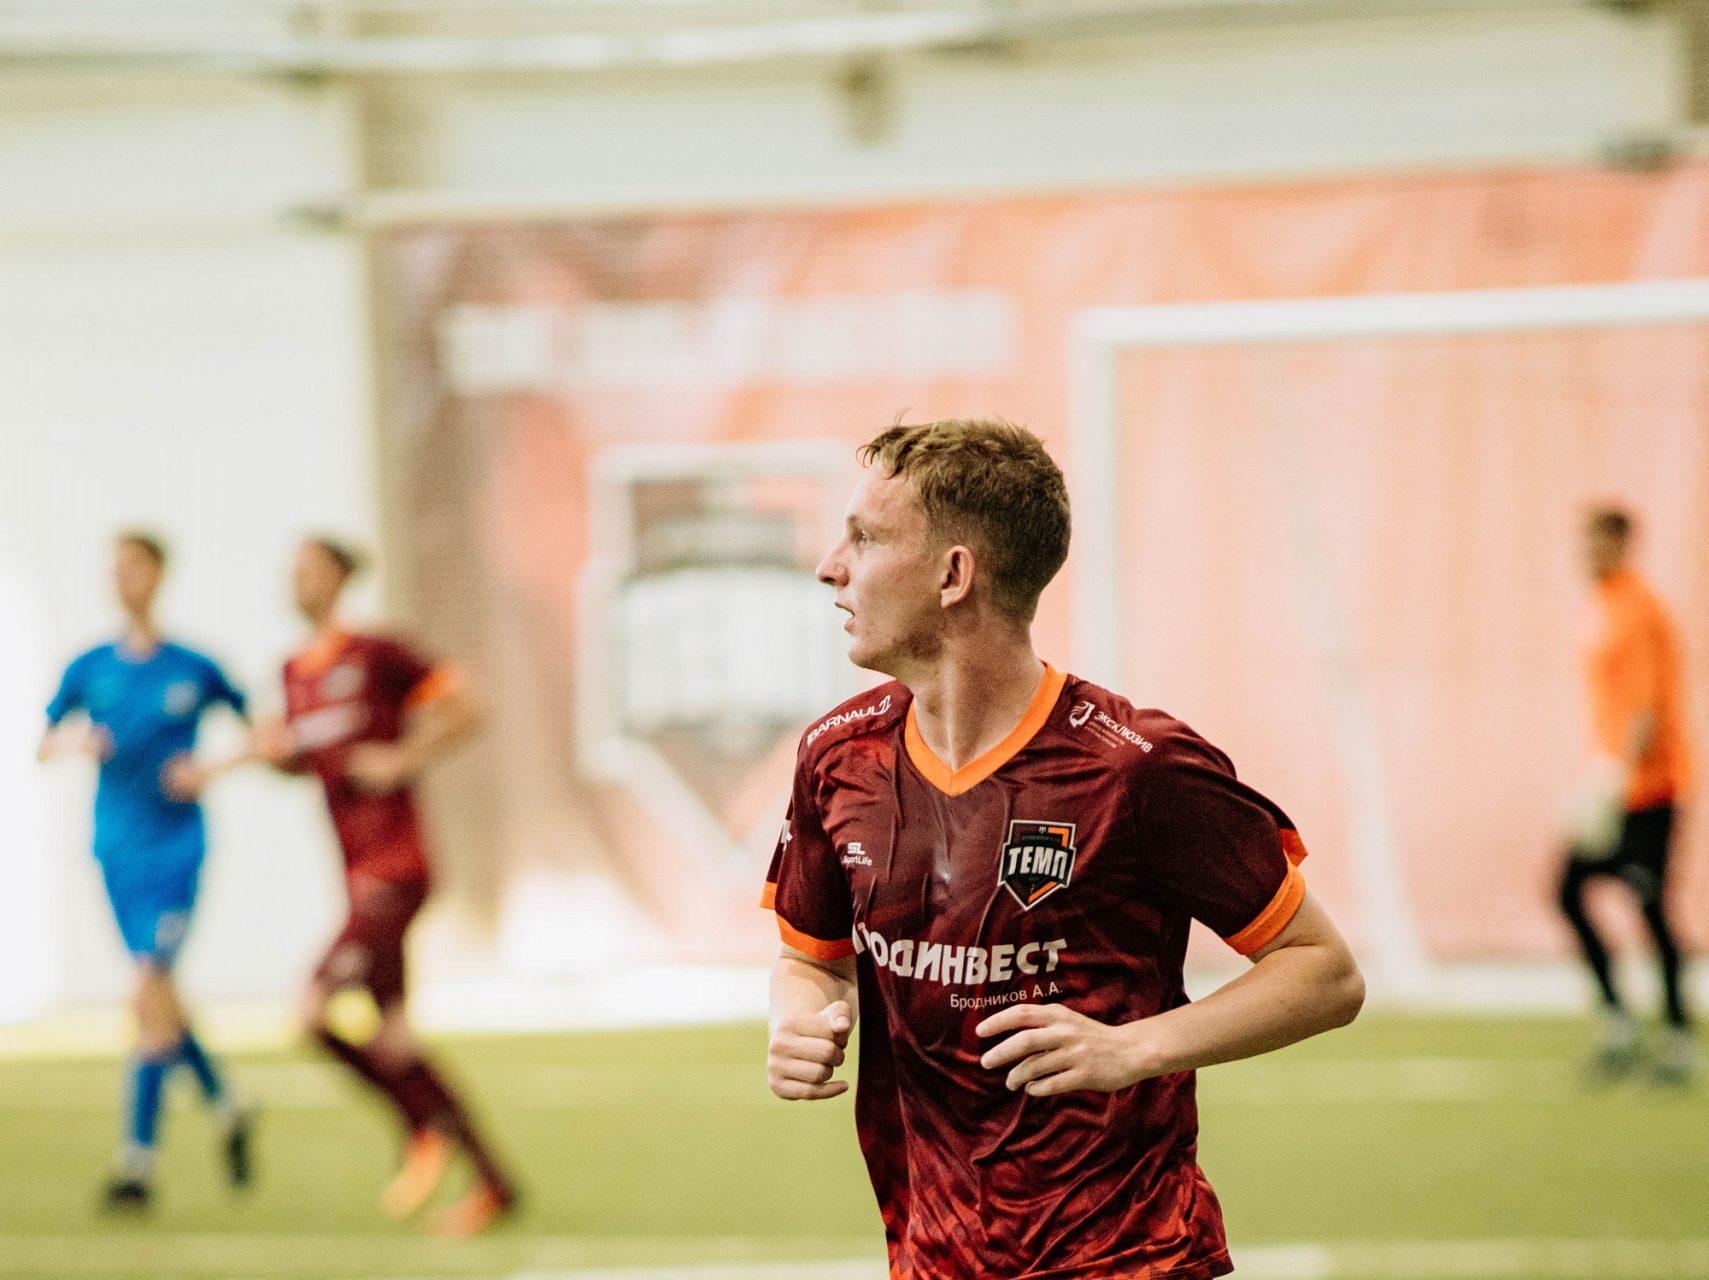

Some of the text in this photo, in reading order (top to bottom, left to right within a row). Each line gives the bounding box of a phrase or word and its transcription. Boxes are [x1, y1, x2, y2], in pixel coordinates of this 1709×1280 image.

[1094, 710, 1154, 753] ЭКСКЛЮЗИВ
[1008, 845, 1069, 880] ТЕМП
[950, 981, 1063, 1011] Бродников А.А.
